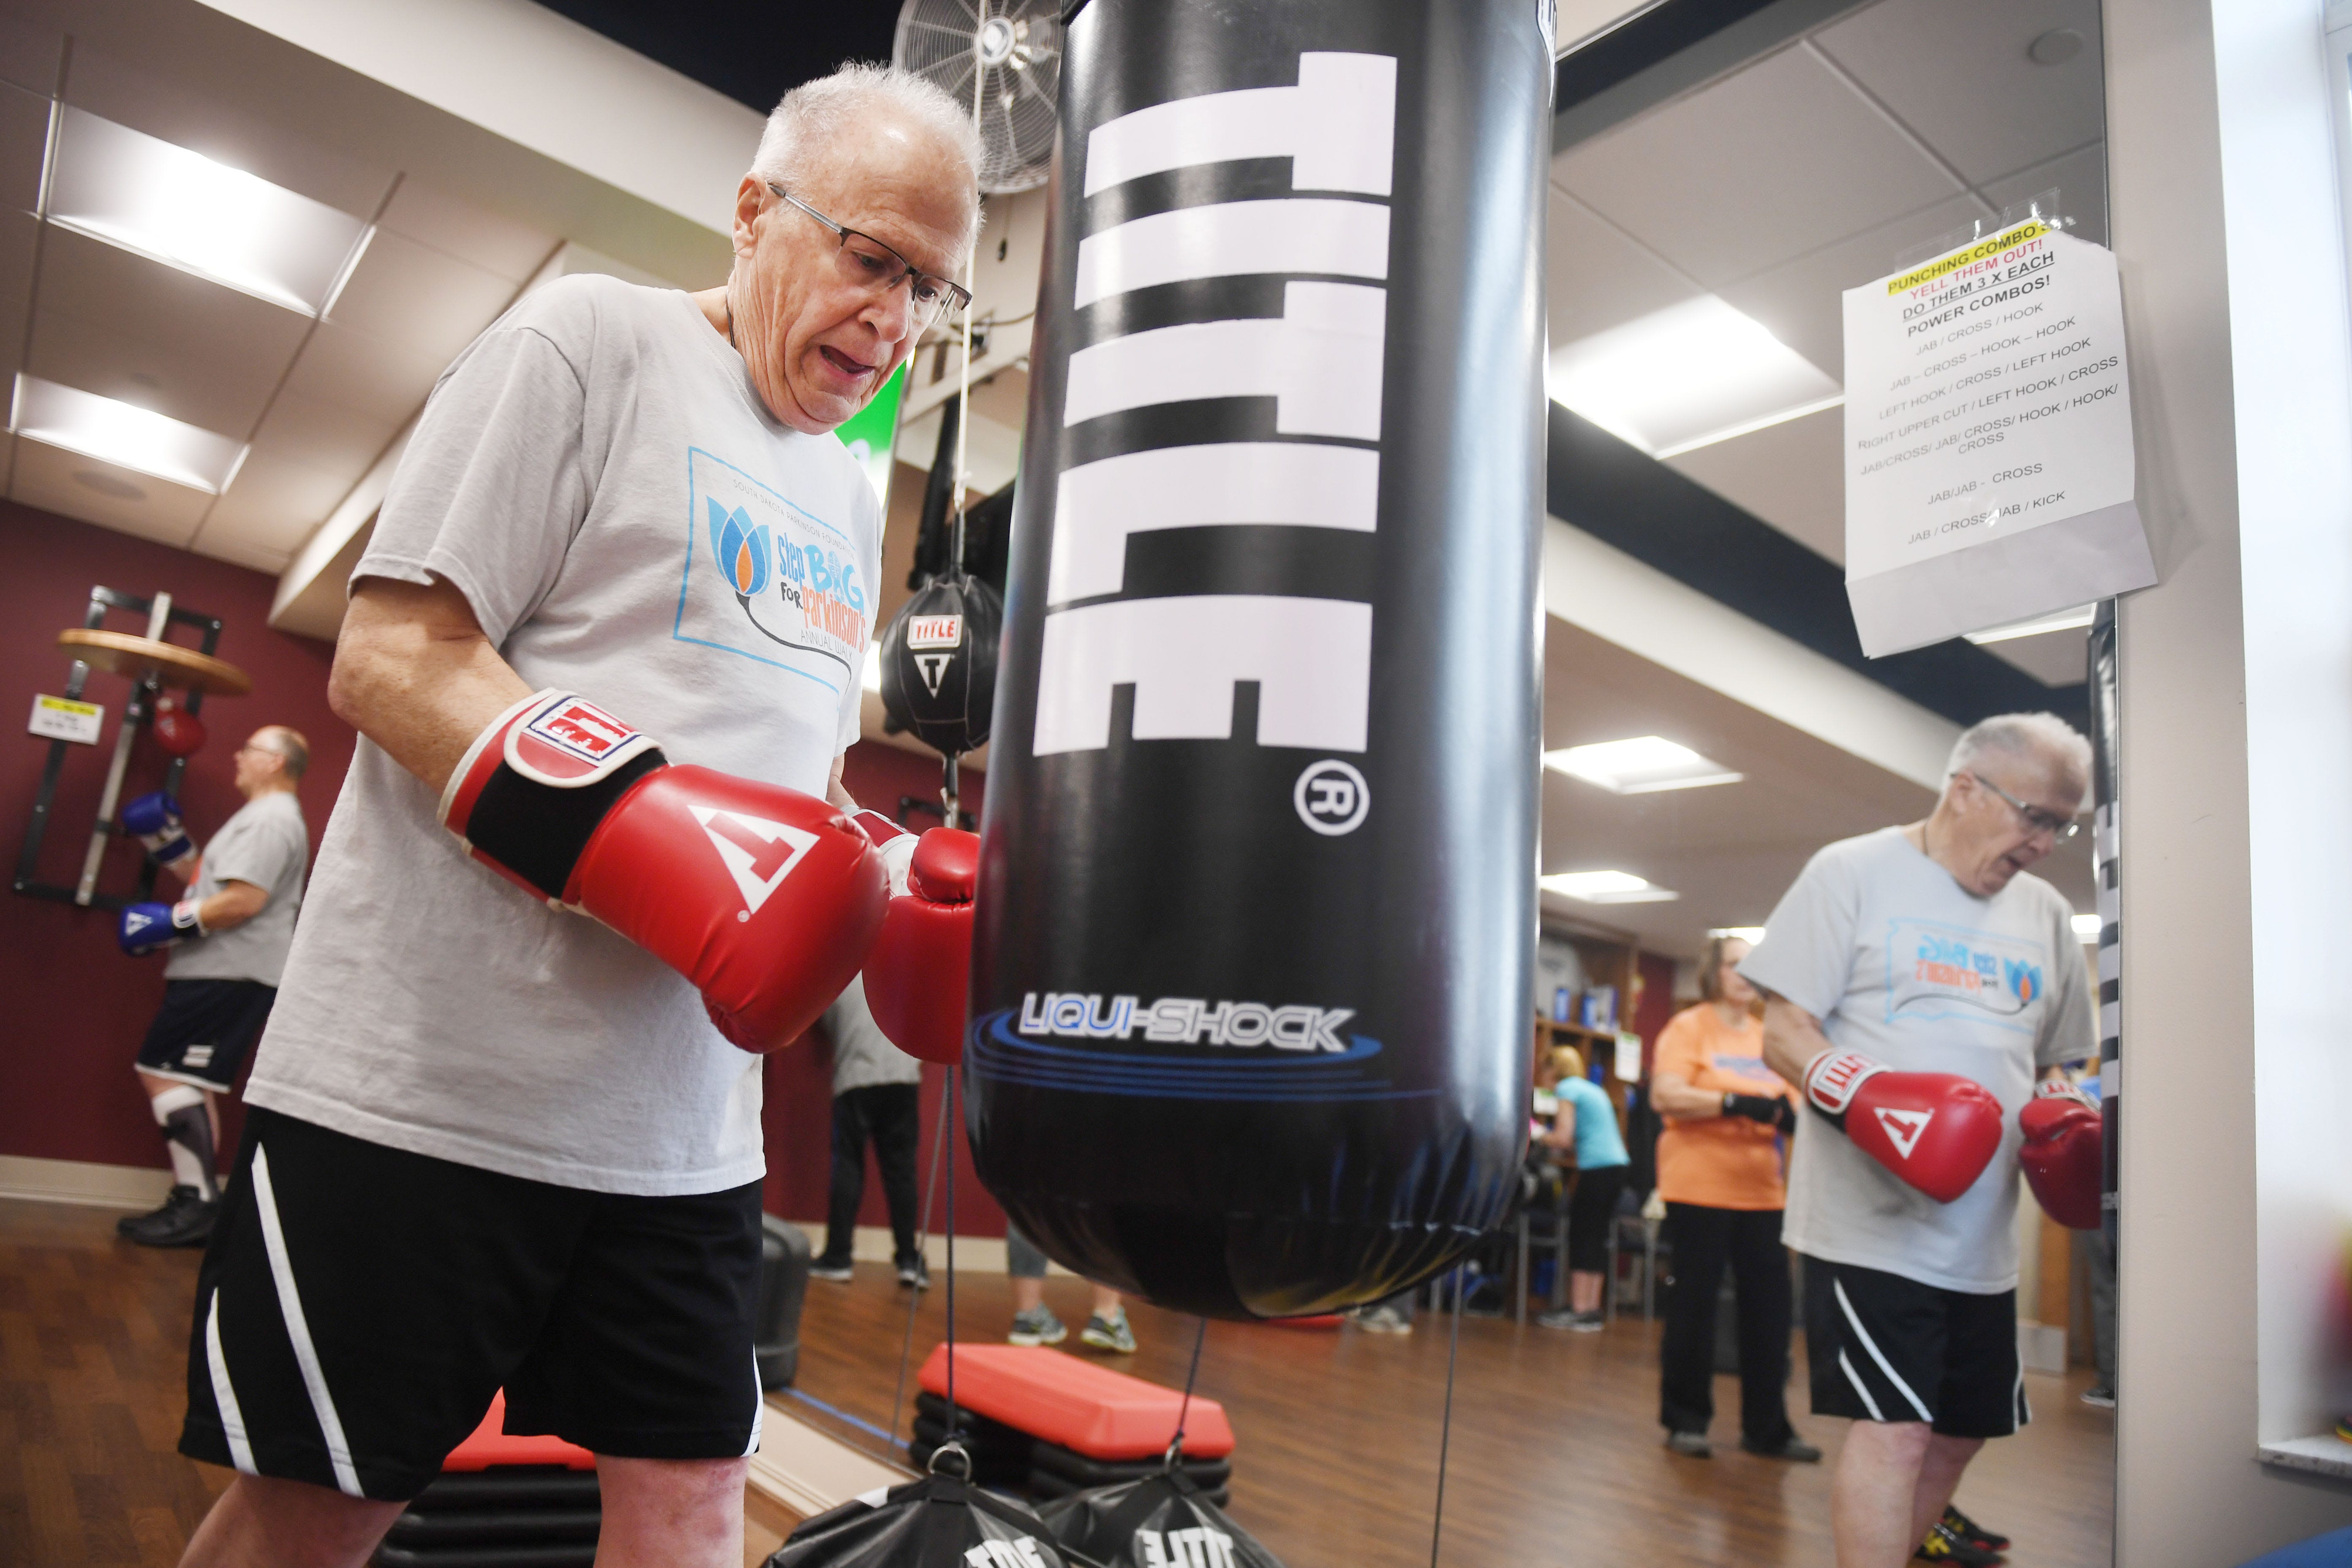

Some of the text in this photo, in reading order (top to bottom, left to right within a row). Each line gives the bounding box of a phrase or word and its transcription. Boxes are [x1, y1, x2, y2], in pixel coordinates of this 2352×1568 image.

[1888, 253, 1969, 294] PUNCHING
[1903, 251, 2054, 320] DO THEM 3 X EACH
[1910, 239, 2043, 299] YELL THEM OUT!
[1908, 275, 2050, 337] POWER COMBOS!
[1916, 340, 1938, 356] JAB
[1948, 319, 1992, 343] CROSS
[2004, 302, 2043, 323] HOOK
[1879, 401, 1908, 420] LEFT
[1911, 386, 1946, 407] HOOK
[1956, 367, 2001, 389] CROSS
[2013, 353, 2047, 371] LEFT
[2051, 337, 2091, 359] HOOK
[1890, 375, 1911, 391] JAB
[1924, 353, 1967, 377] CROSS
[1982, 336, 2020, 355] HOOK
[2037, 316, 2076, 338] HOOK
[1033, 52, 1397, 756] TITLE
[1859, 431, 1895, 449] RIGHT
[1899, 415, 1940, 437] UPPER
[1943, 403, 1968, 421] CUT
[1979, 389, 2012, 408] LEFT
[2016, 377, 2057, 397] HOOK
[2069, 356, 2118, 381] CROSS
[1965, 416, 2015, 439] CROSS/
[2020, 403, 2061, 422] HOOK
[2073, 384, 2118, 407] HOOK/
[1958, 432, 2004, 454] CROSS
[733, 479, 758, 500] SOUTH
[760, 494, 784, 517] DAKOTA
[787, 511, 820, 538] PARKINSON
[1928, 481, 1977, 505] JAB/JAB
[1993, 463, 2043, 484] CROSS
[1908, 530, 1931, 544] JAB
[2033, 490, 2066, 509] KICK
[778, 532, 805, 591] step
[781, 582, 866, 653] FOR parkinson's
[801, 629, 853, 664] ANNUAL WALK
[916, 621, 956, 640] TITLE
[1018, 992, 1356, 1053] LIQUI-SHOCK
